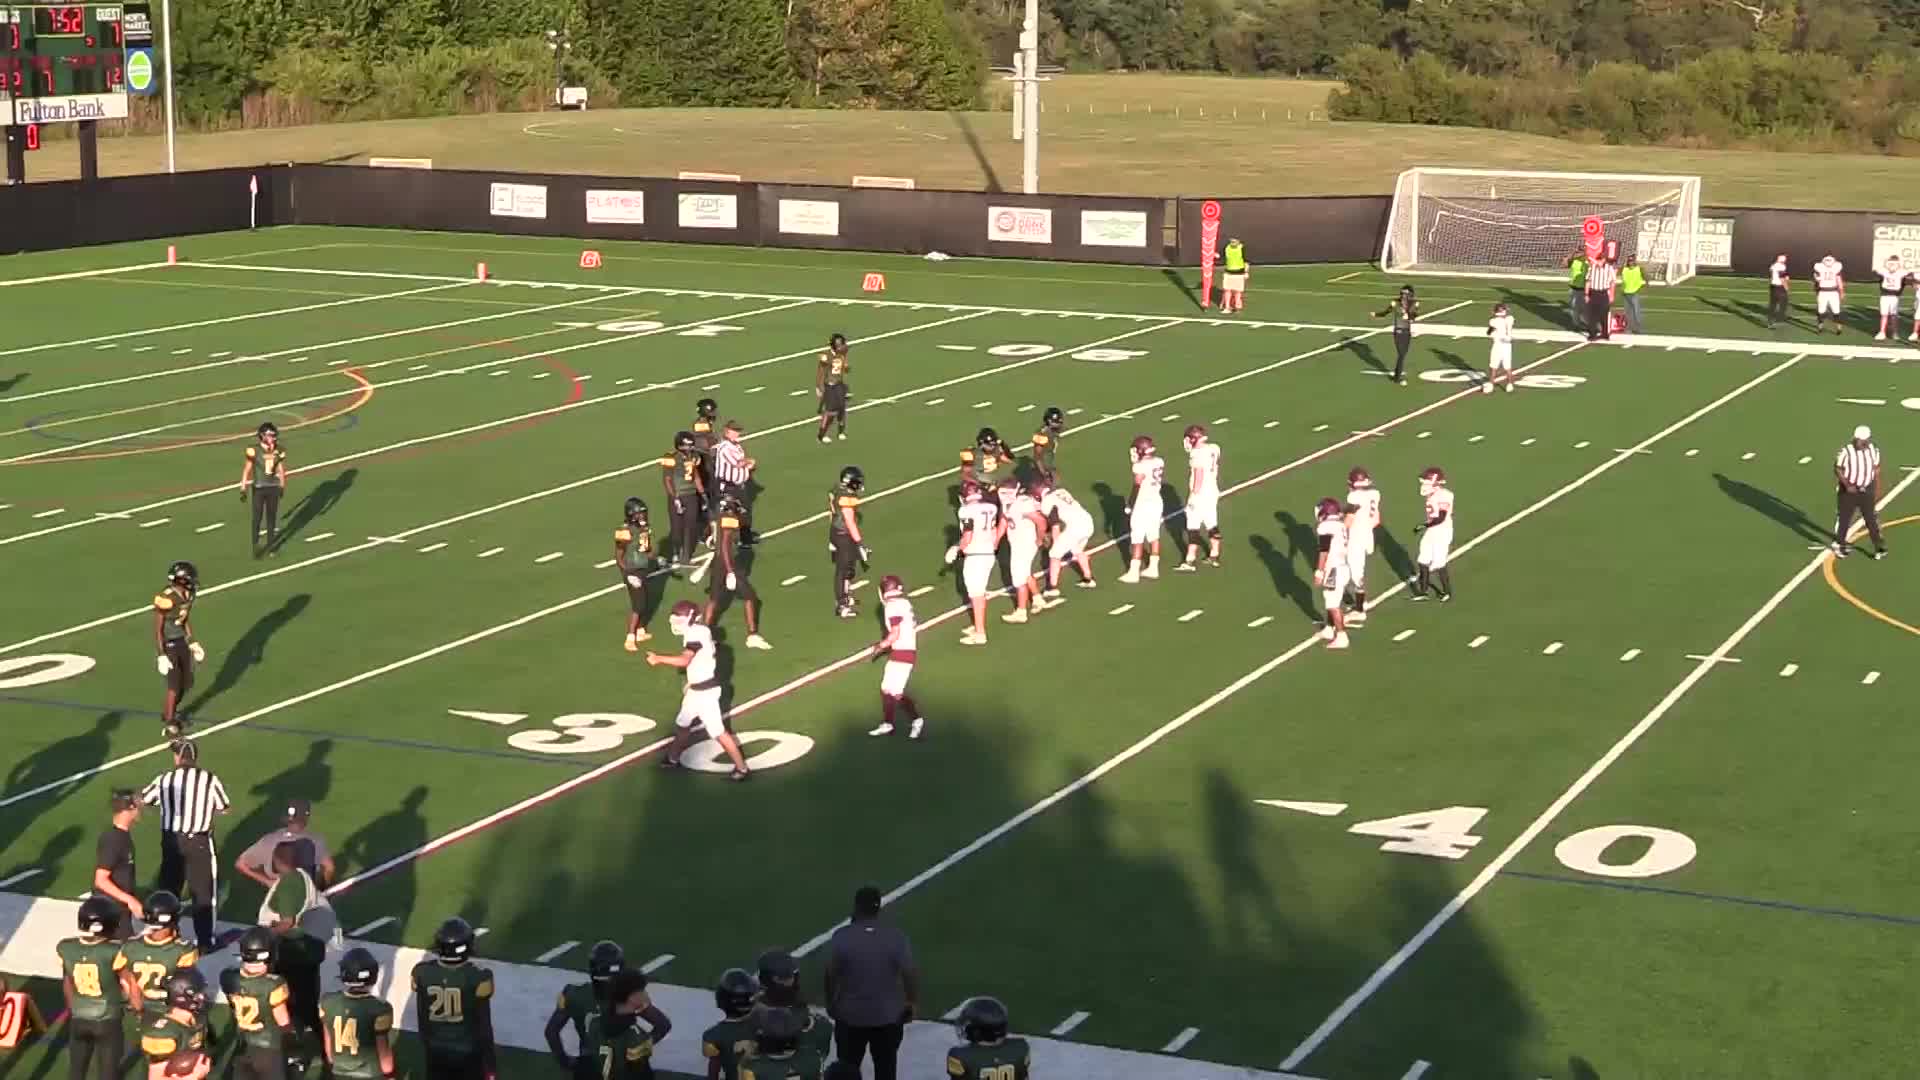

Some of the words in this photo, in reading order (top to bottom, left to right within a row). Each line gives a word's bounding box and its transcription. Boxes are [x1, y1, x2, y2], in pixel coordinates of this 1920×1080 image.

[19, 99, 66, 122] Fulton
[68, 97, 105, 118] Bank
[427, 985, 464, 1023] 20
[333, 1015, 360, 1056] 14
